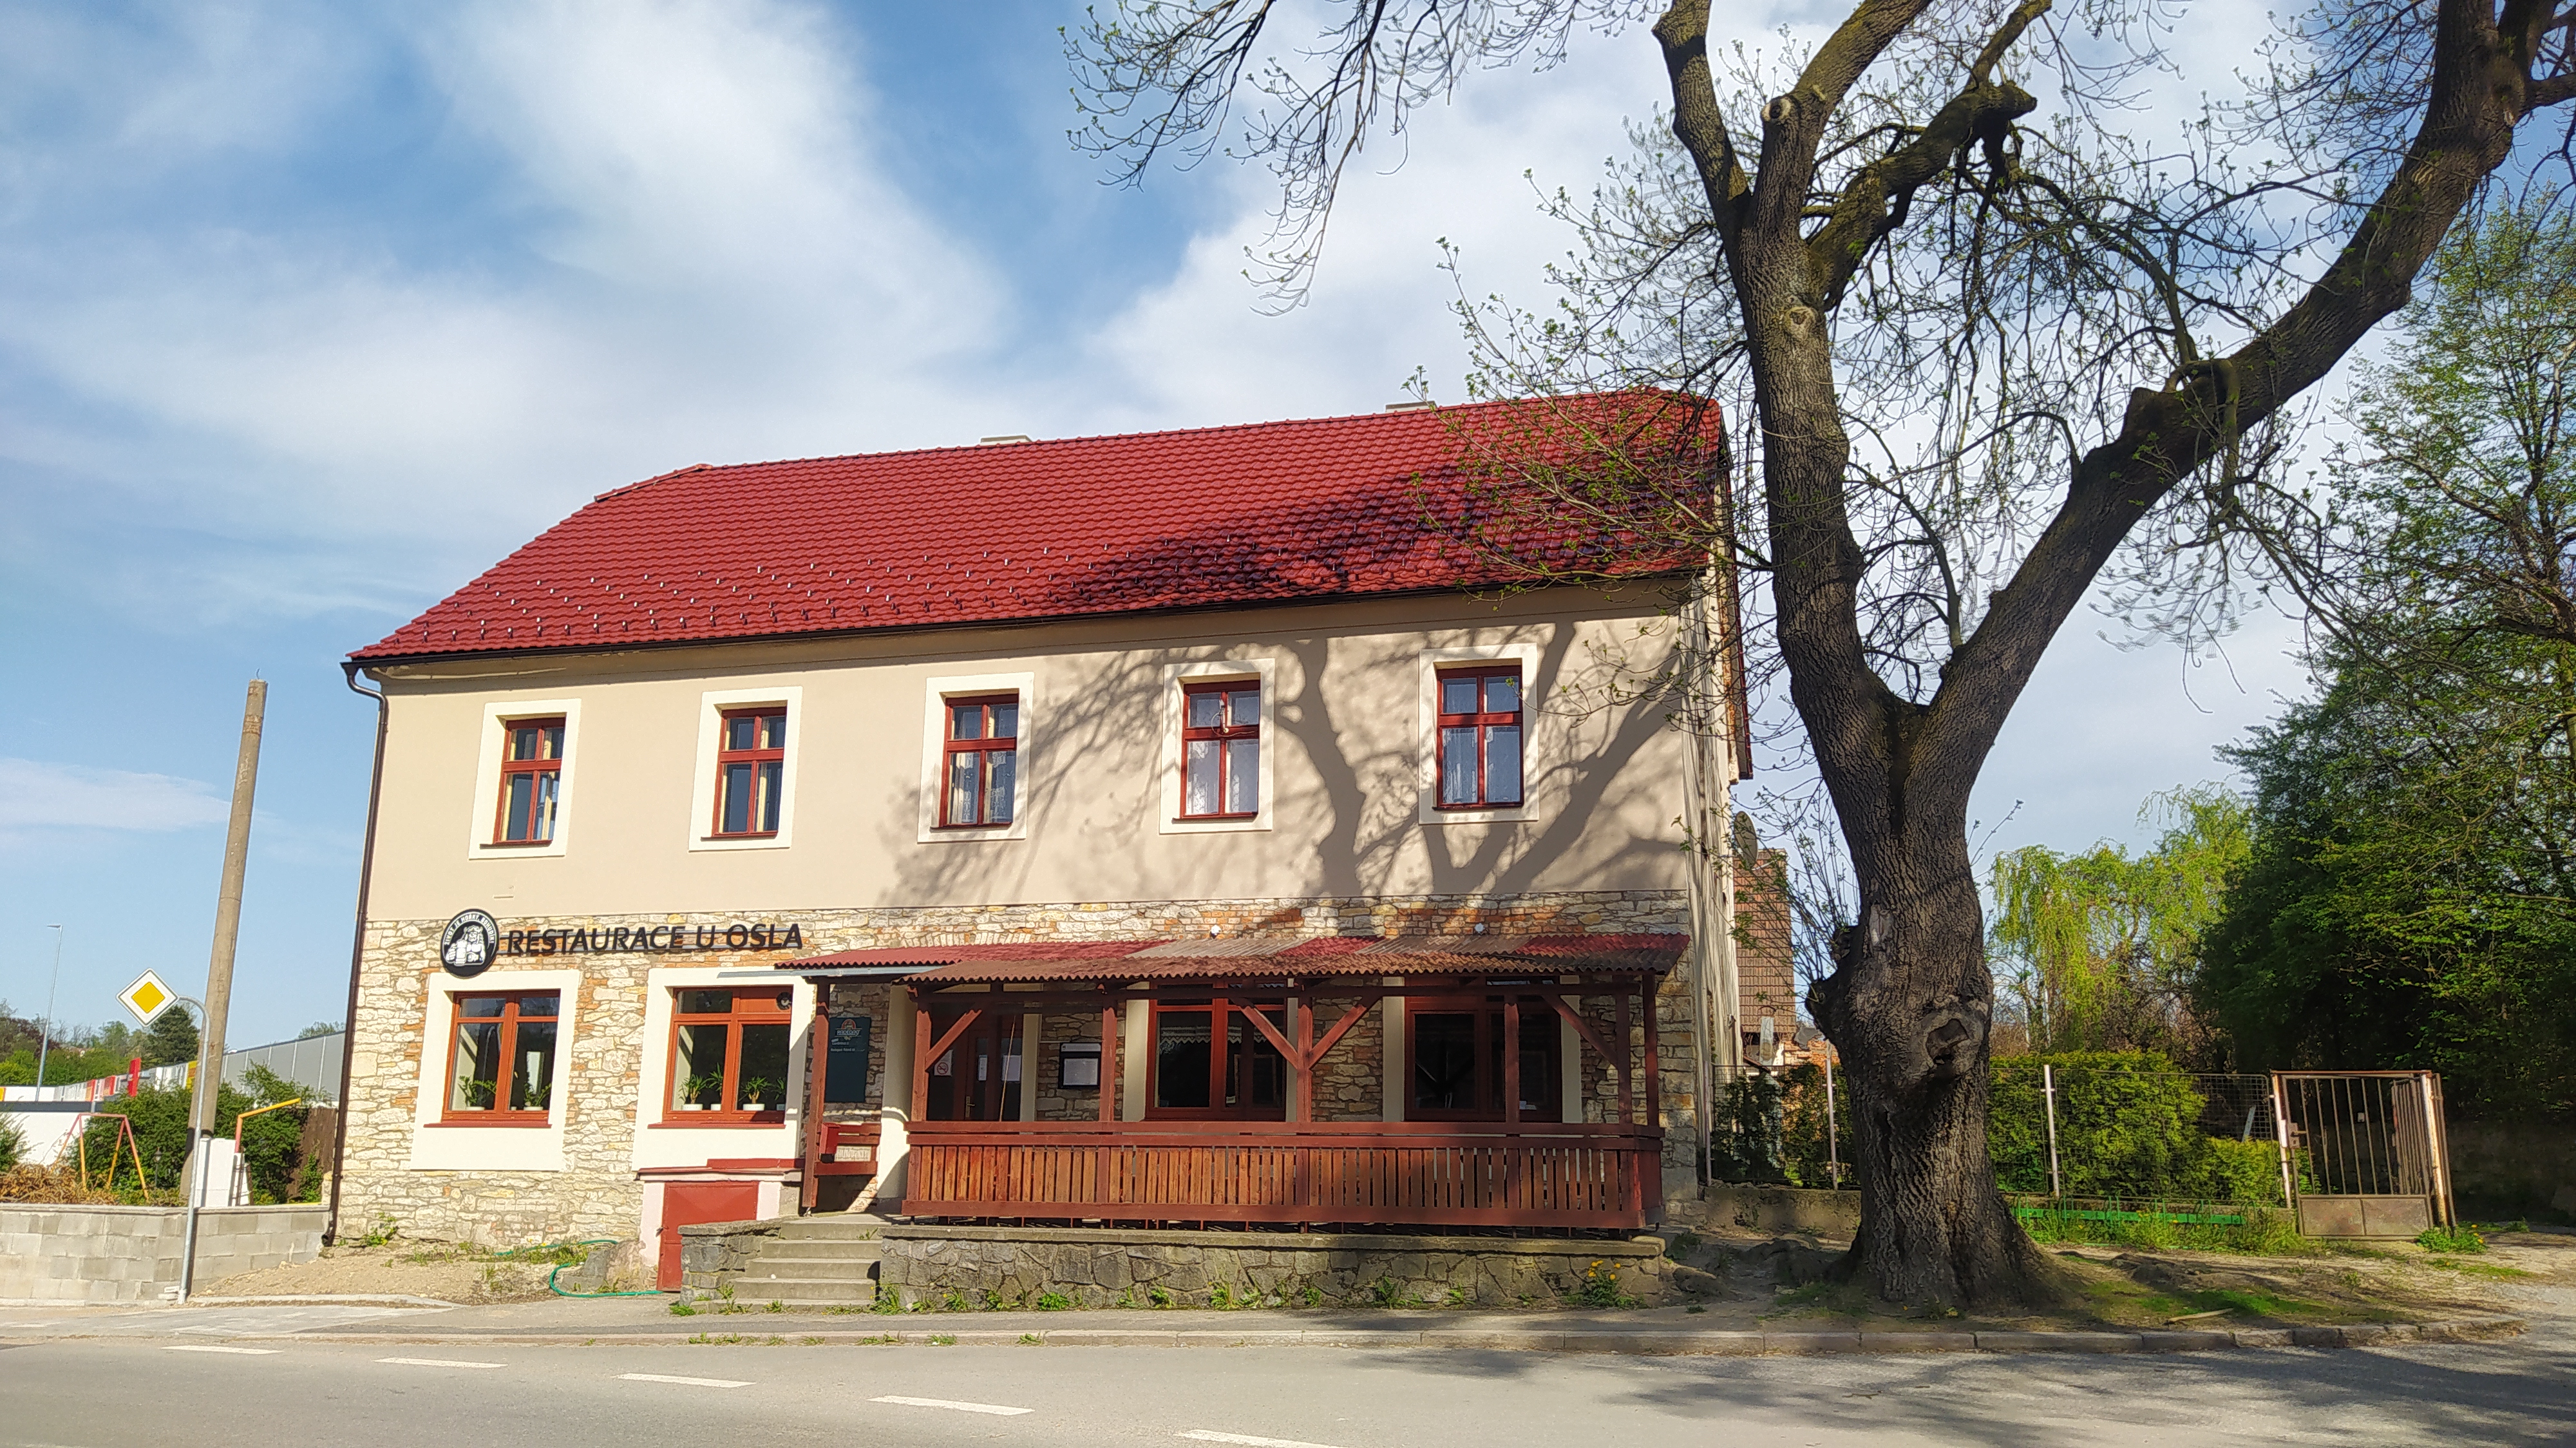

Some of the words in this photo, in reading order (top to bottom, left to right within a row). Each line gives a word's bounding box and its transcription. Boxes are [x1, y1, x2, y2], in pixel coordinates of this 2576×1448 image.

[507, 926, 686, 954] RESTAURACE
[696, 924, 716, 948] U
[726, 923, 803, 949] OSLA
